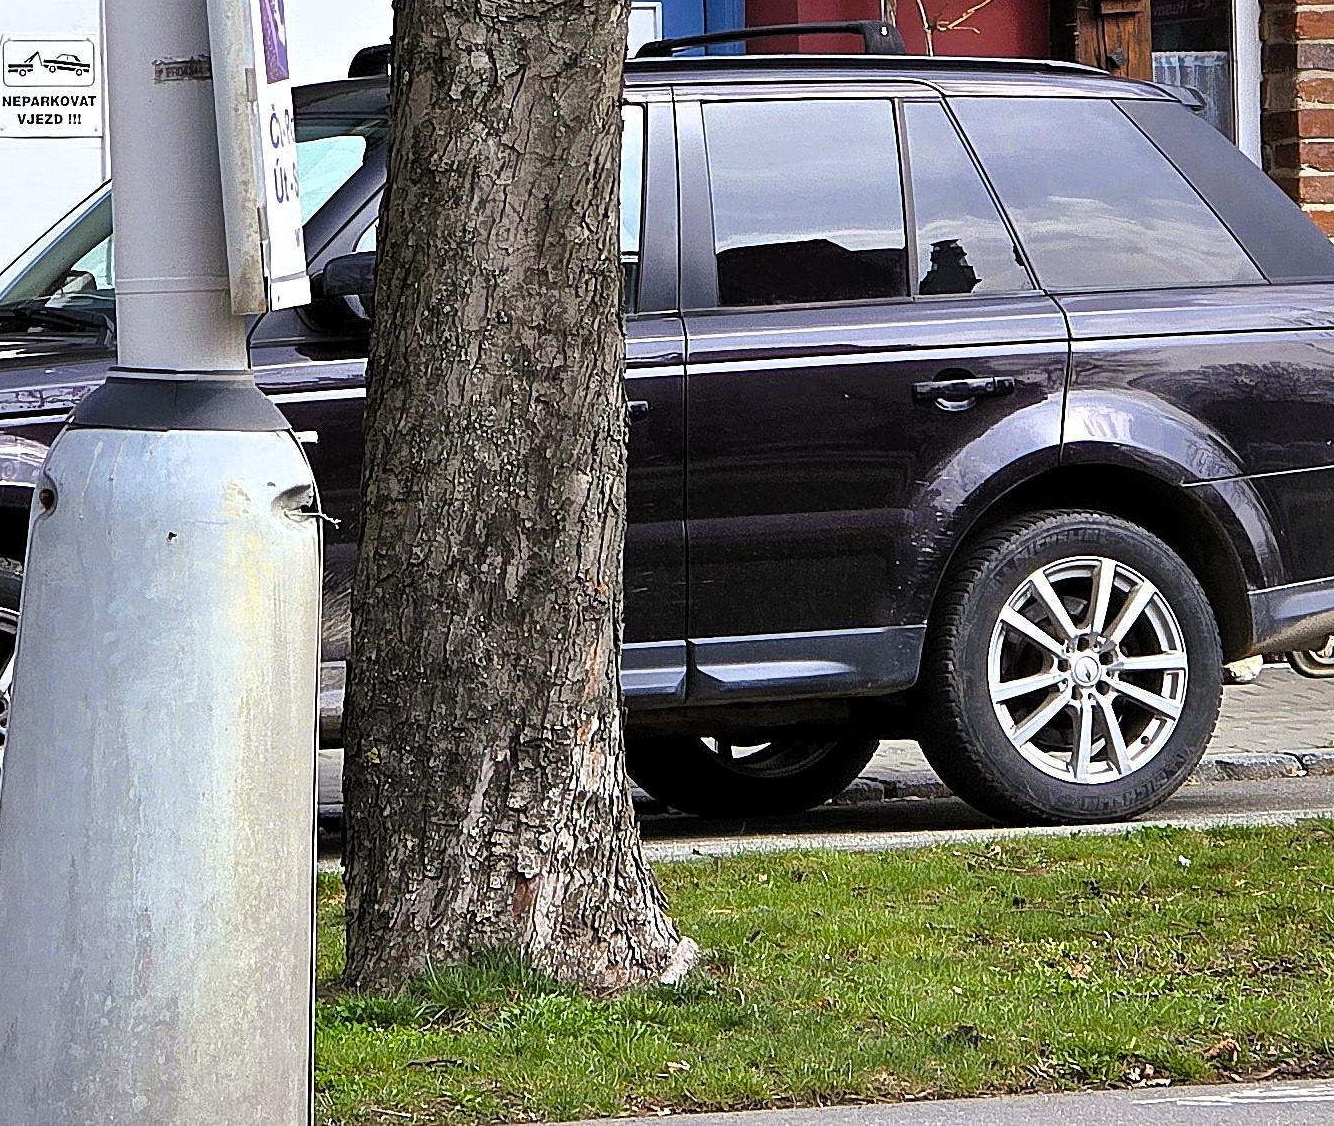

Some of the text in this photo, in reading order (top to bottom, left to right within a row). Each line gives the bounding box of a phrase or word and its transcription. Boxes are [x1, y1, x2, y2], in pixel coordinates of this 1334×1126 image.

[2, 95, 97, 107] NEPARKOVAT
[17, 113, 82, 125] VJEZD !!!
